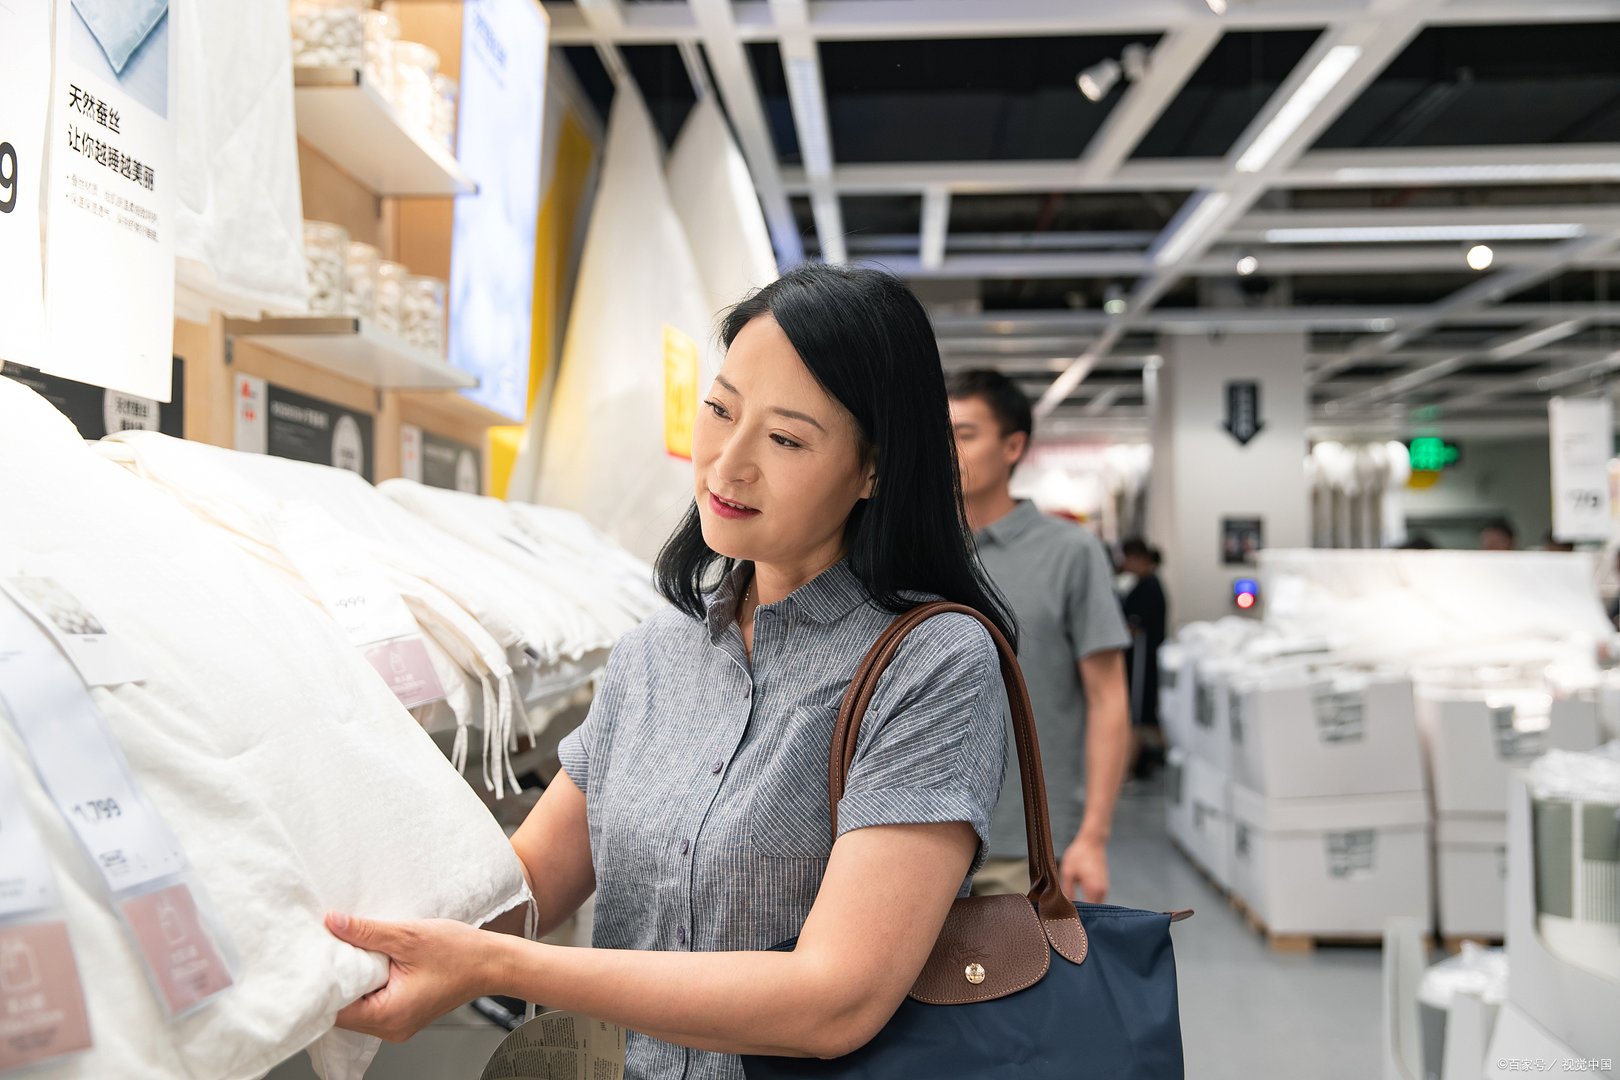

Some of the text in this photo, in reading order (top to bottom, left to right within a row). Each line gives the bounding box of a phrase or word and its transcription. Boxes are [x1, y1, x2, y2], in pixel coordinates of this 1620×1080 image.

[69, 84, 120, 134] 天然蚕丝
[68, 124, 154, 191] 让你越睡越美丽
